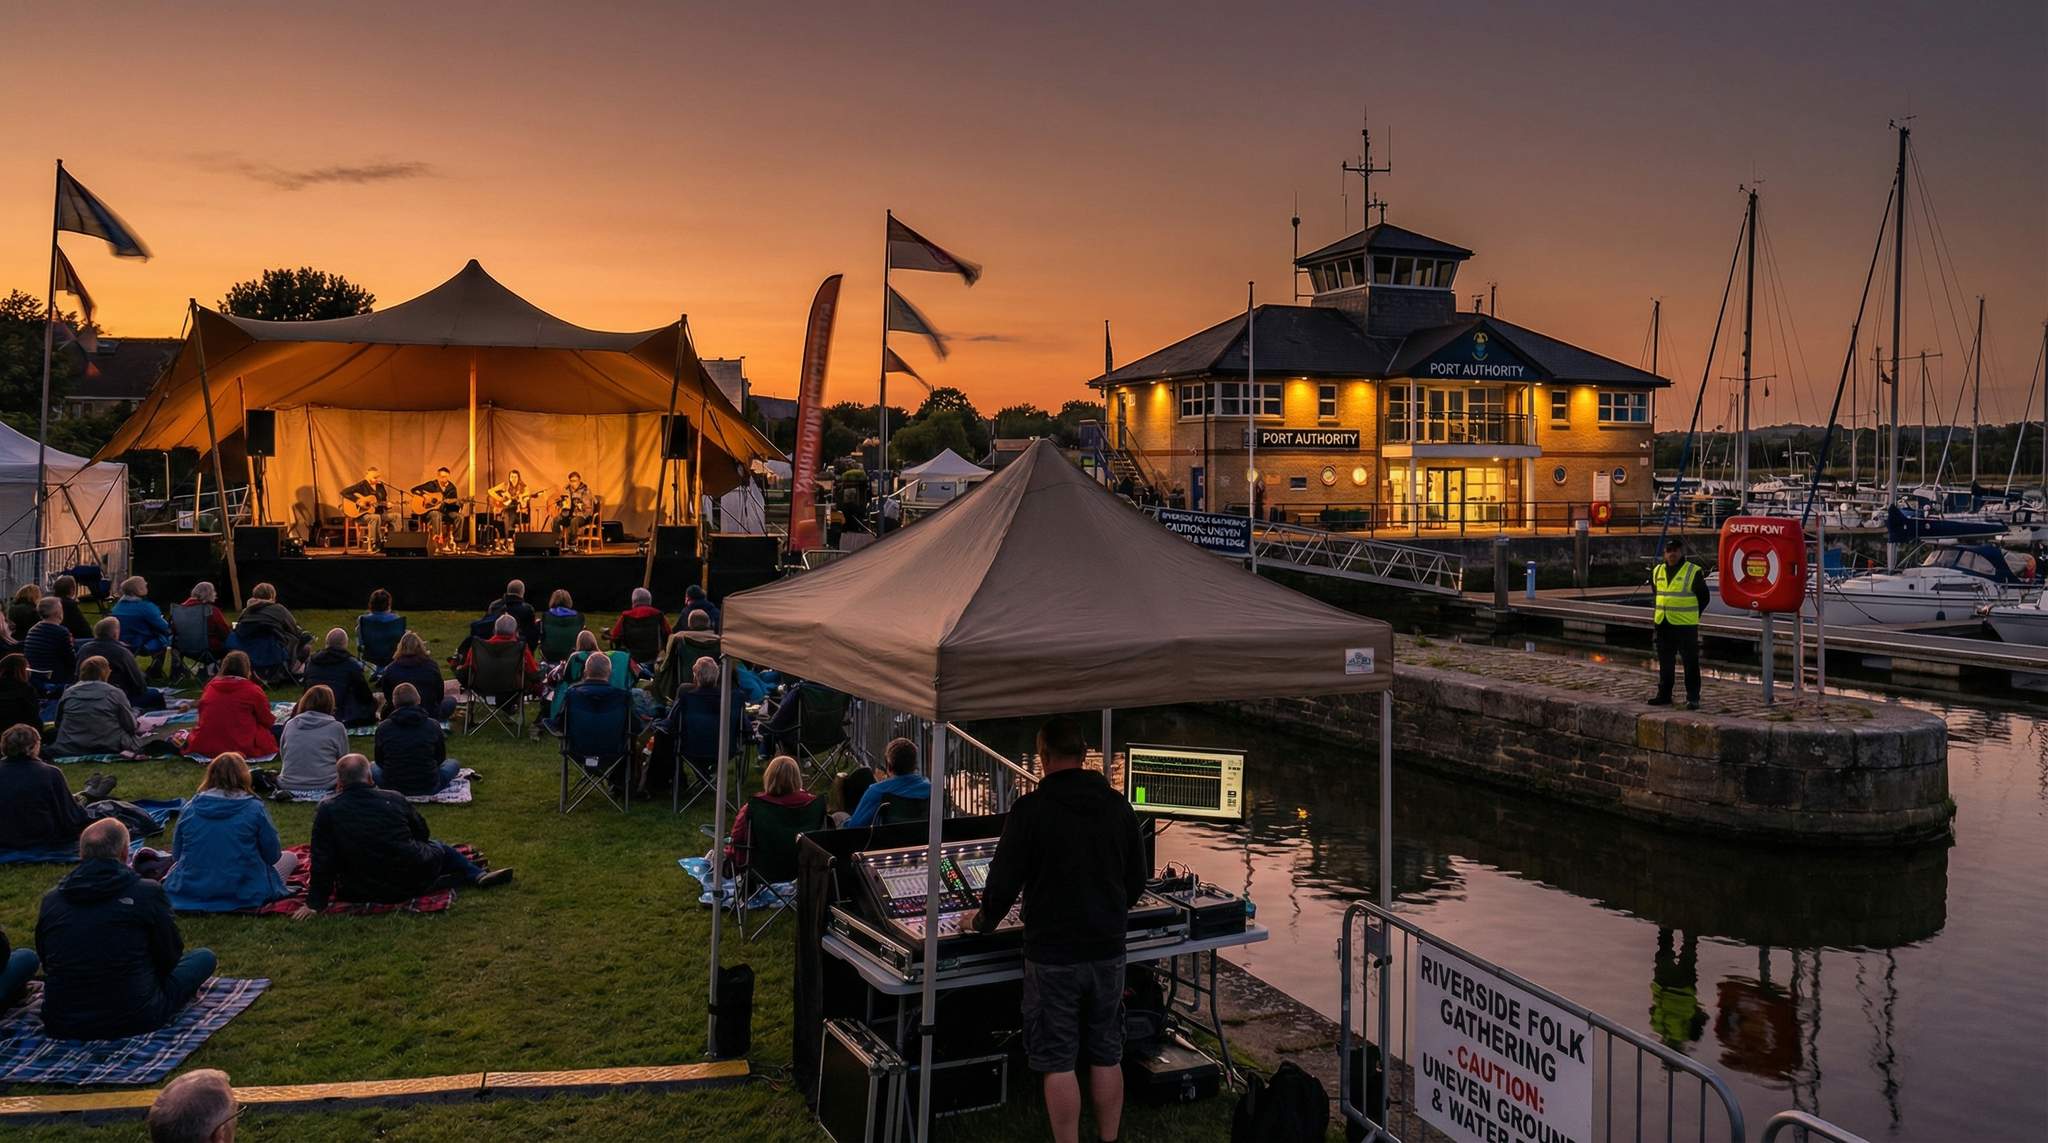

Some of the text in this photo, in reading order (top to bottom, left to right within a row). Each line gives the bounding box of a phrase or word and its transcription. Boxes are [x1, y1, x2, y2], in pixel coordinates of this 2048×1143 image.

[1430, 363, 1525, 377] PORT AUTHORITY
[1263, 432, 1358, 445] PORT AUTHORITY
[1730, 524, 1785, 535] SAFETY POINT
[1421, 955, 1586, 1065] RIVERSIDE FOLK
[1440, 998, 1556, 1083] GATHERING
[1423, 1052, 1577, 1143] UNEVEN GROUN
[1457, 1045, 1545, 1115] CAUTION:
[1431, 1087, 1510, 1143] & WATER
